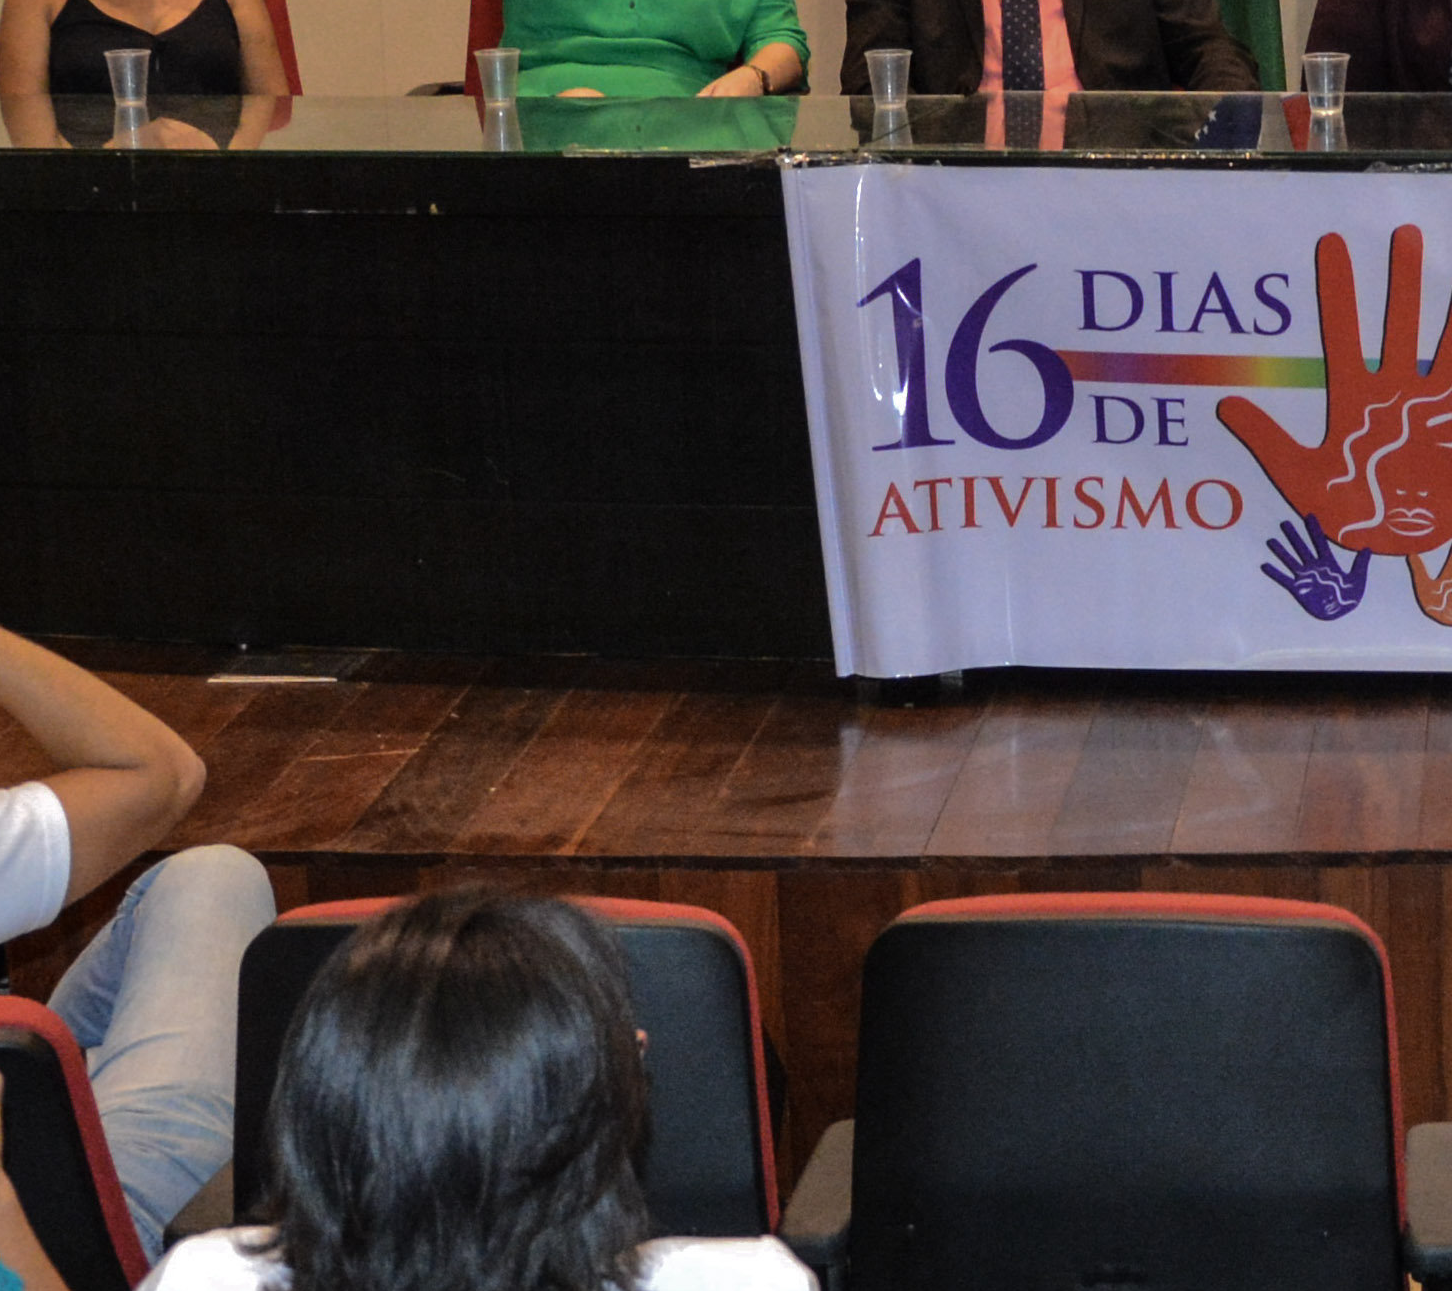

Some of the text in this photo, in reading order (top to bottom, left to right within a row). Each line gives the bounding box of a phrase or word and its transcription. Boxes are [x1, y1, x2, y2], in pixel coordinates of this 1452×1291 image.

[856, 258, 1292, 451] 16 DIAS
[1088, 394, 1189, 446] DE
[868, 476, 1244, 537] ATIVISMO
